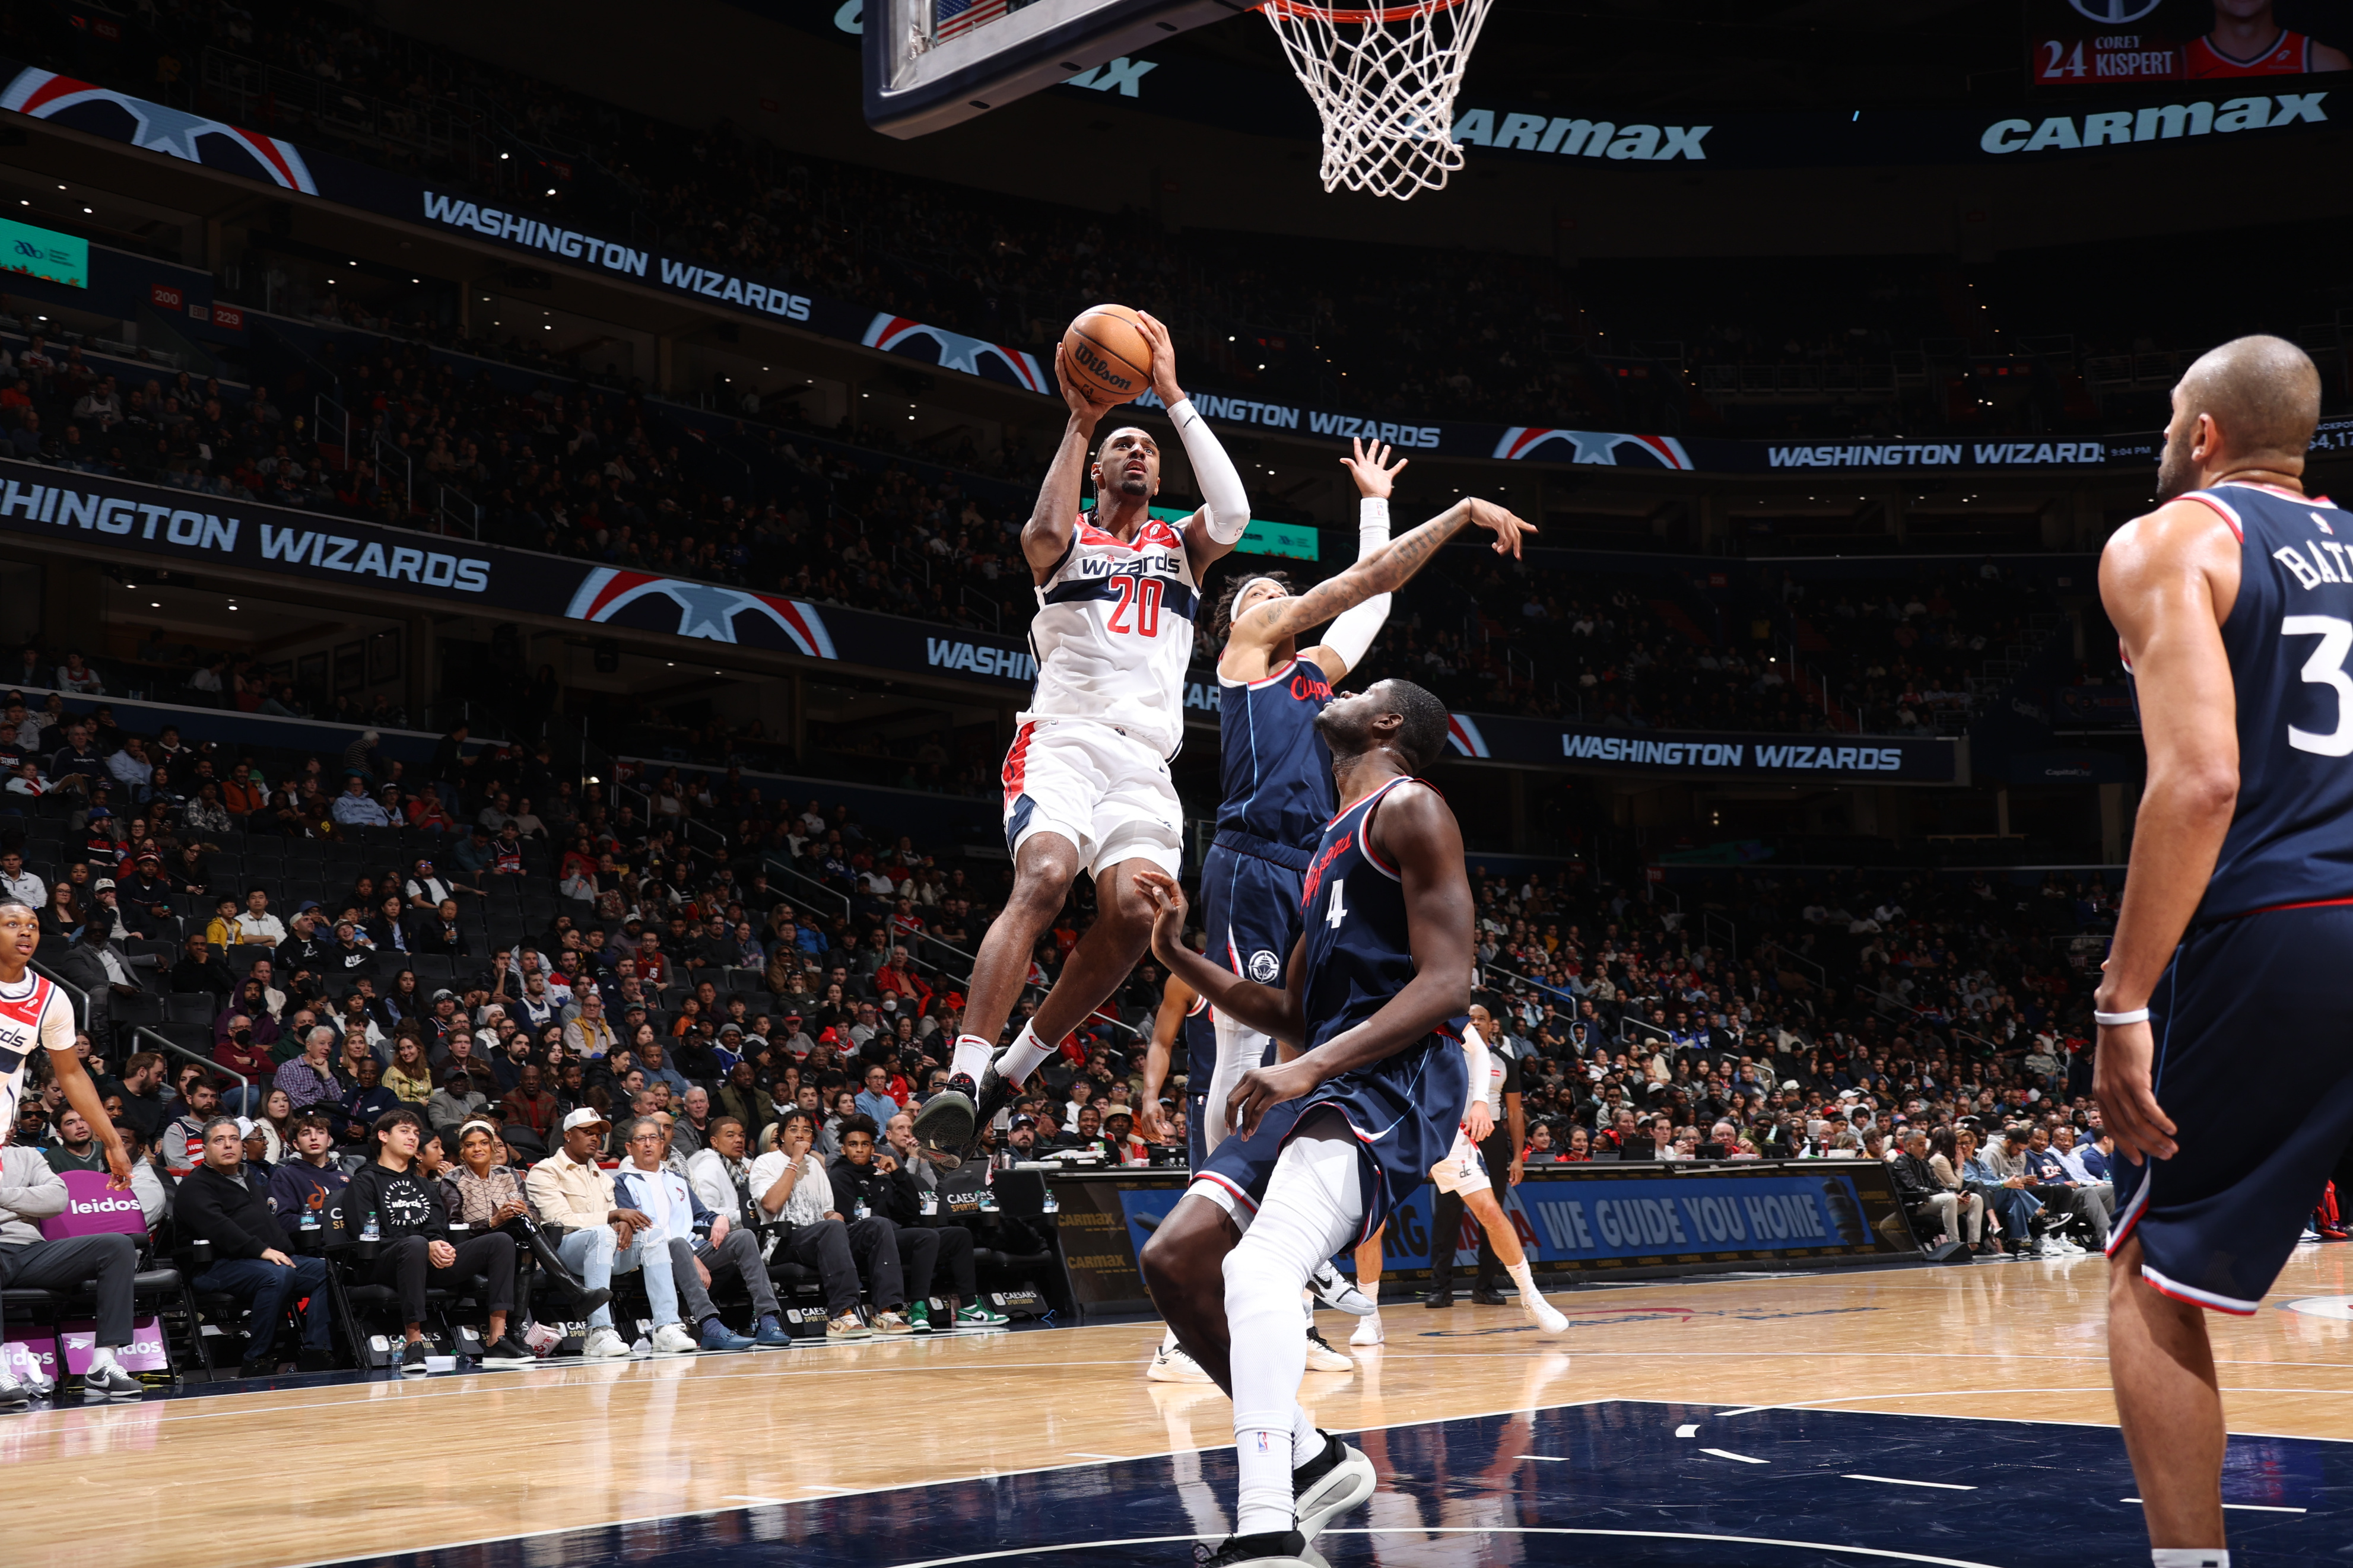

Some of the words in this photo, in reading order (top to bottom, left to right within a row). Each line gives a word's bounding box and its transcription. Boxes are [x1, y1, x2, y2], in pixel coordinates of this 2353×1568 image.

[2041, 40, 2088, 78] 24
[2095, 36, 2143, 50] COREY
[2095, 51, 2174, 77] KISPERT
[423, 190, 649, 277] WASHINGTON
[660, 257, 812, 322] WIZARDS
[154, 290, 179, 306] 200
[216, 310, 240, 326] 229
[1075, 342, 1132, 390] Wilson
[1126, 387, 1300, 429] WAHINGTON
[1309, 411, 1441, 449] WIZARDS
[1768, 444, 1963, 467] WASHINGTON
[2134, 446, 2152, 456] PM
[0, 478, 240, 553] HINGTON
[259, 523, 491, 593] WIZARDS
[1144, 533, 1173, 543] Robinhood
[1081, 551, 1181, 578] wizards
[1107, 574, 1166, 639] 20
[2280, 614, 2353, 758] 3
[1561, 733, 1744, 768] WASHINGTON
[1755, 745, 1902, 771] WIZARDS
[1325, 879, 1348, 929] 4
[71, 1197, 141, 1216] leidos
[1536, 1201, 1595, 1249] WE
[1595, 1198, 1687, 1248] GUIDE
[1681, 1195, 1747, 1243] YOU
[1744, 1194, 1827, 1241] HOME
[1004, 1290, 1037, 1300] CAESARS
